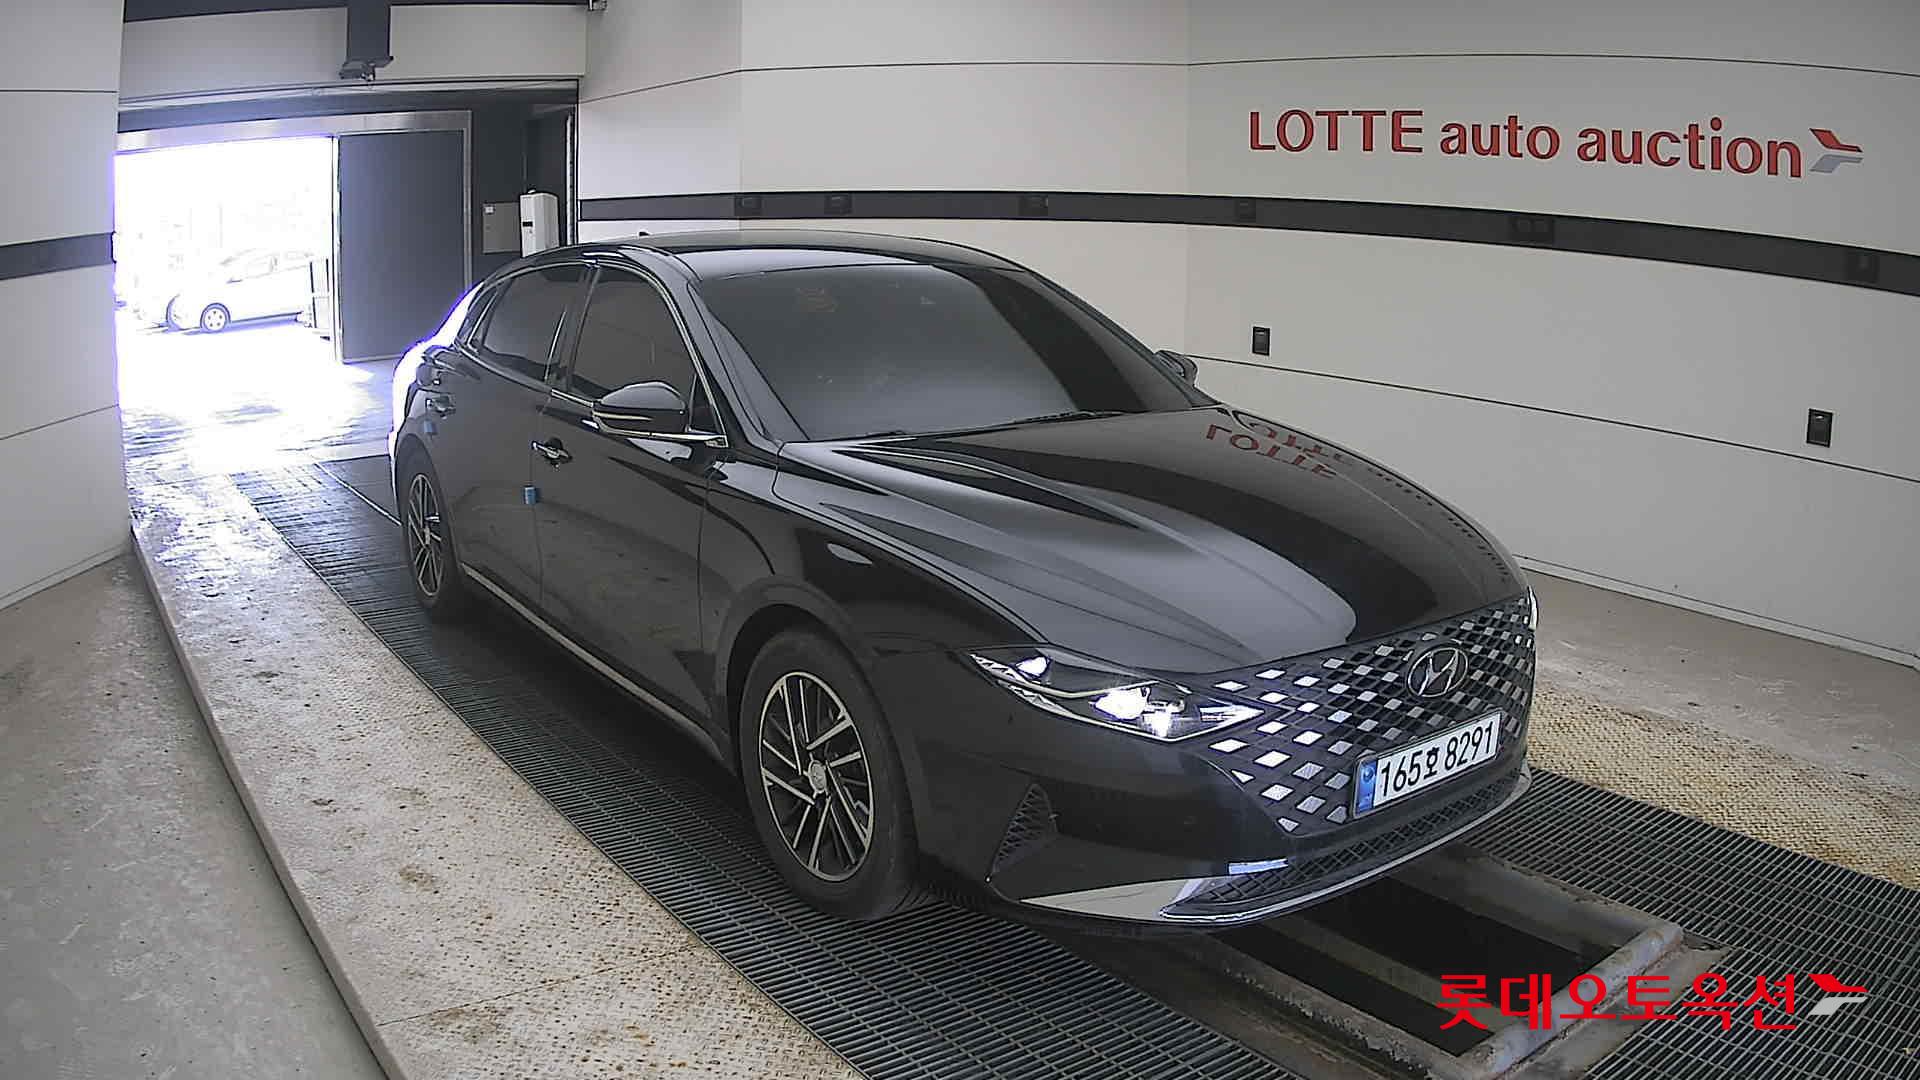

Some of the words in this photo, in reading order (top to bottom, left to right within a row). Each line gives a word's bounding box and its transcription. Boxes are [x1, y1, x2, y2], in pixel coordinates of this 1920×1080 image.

[1248, 109, 1423, 153] LOTTE
[1439, 115, 1561, 161] auto
[1576, 116, 1802, 179] auction
[1381, 746, 1440, 797] 165호
[1444, 721, 1494, 771] 8291
